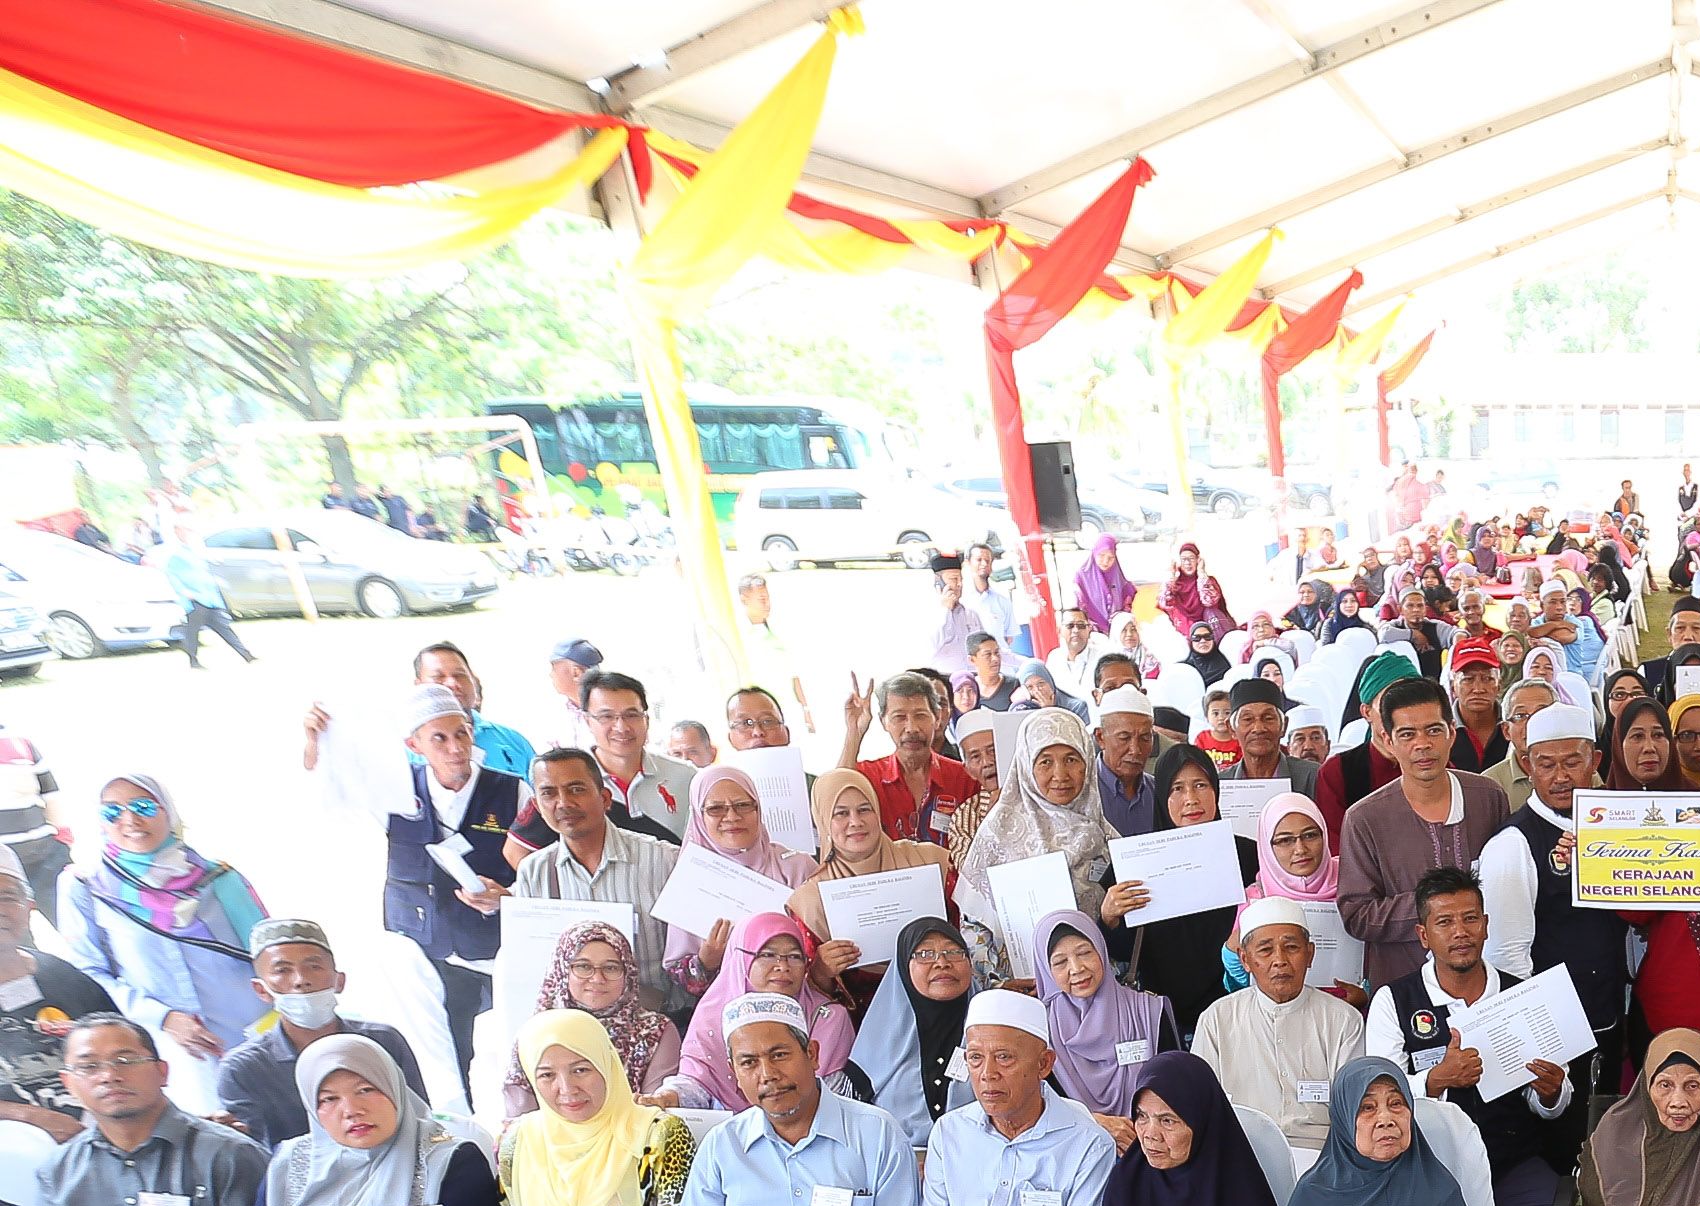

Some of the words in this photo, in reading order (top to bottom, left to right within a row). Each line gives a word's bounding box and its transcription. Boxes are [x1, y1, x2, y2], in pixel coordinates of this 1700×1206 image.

[1582, 842, 1652, 857] Terima
[1612, 870, 1694, 880] KERAJAAN
[1582, 885, 1637, 895] NEGERI
